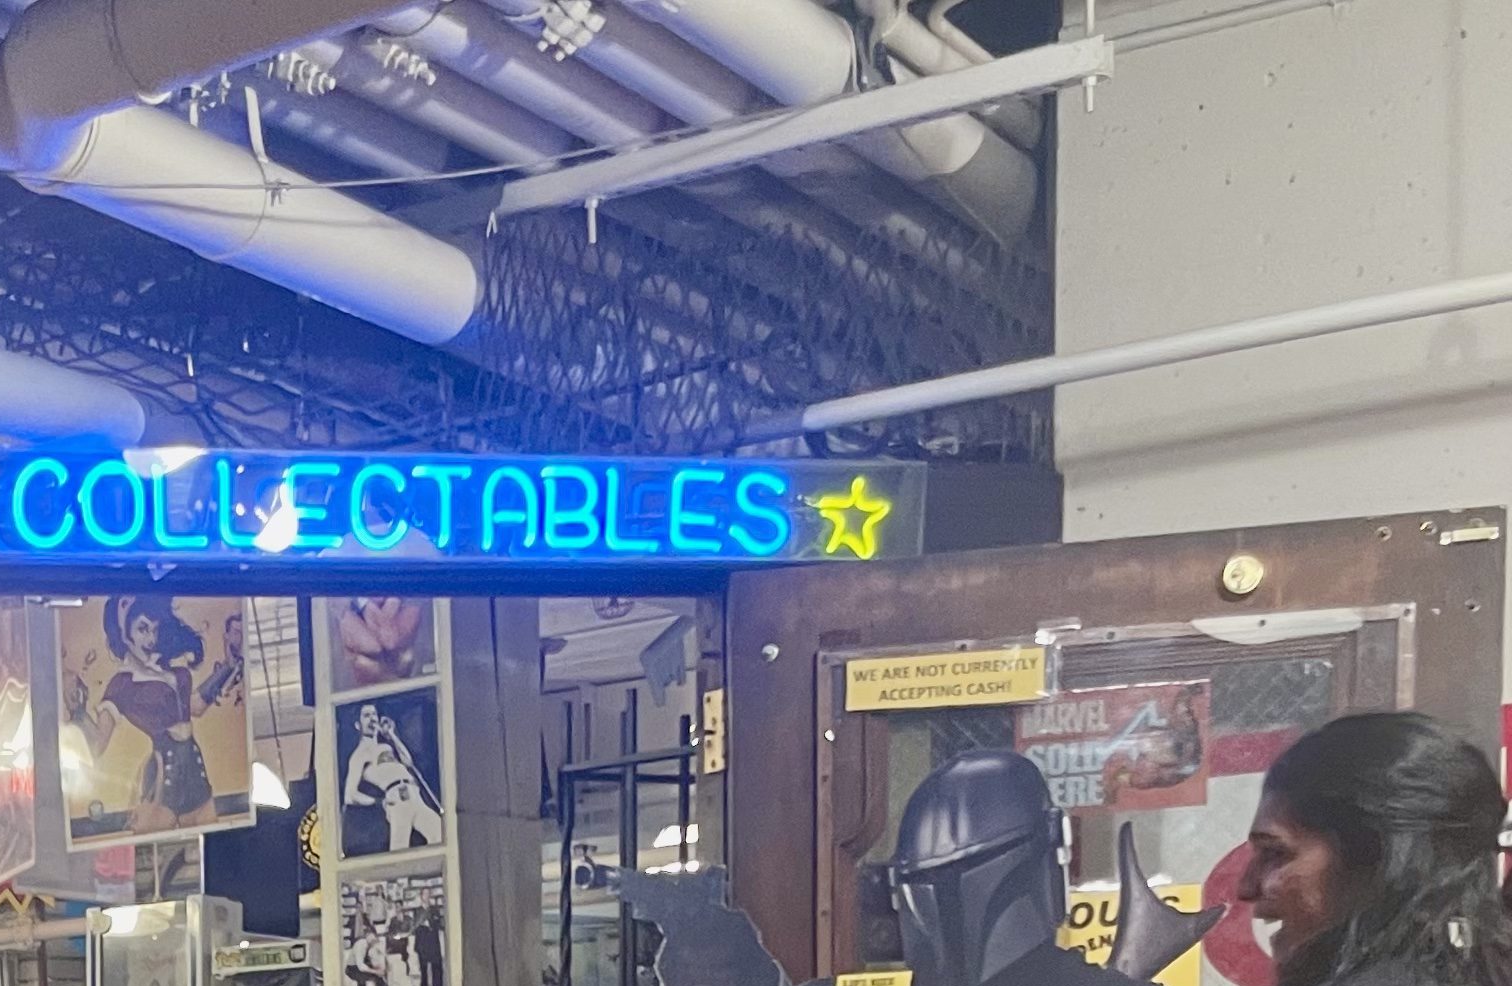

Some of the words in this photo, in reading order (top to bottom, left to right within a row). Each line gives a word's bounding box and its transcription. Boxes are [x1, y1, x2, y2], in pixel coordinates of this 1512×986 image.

[11, 455, 791, 557] COLLECTABLES
[853, 668, 877, 682] WE
[881, 666, 910, 680] ARE
[915, 664, 947, 677] NOT
[951, 657, 1039, 676] CURRENTLY
[878, 684, 962, 702] ACCEPTING
[1048, 774, 1106, 808] ERE
